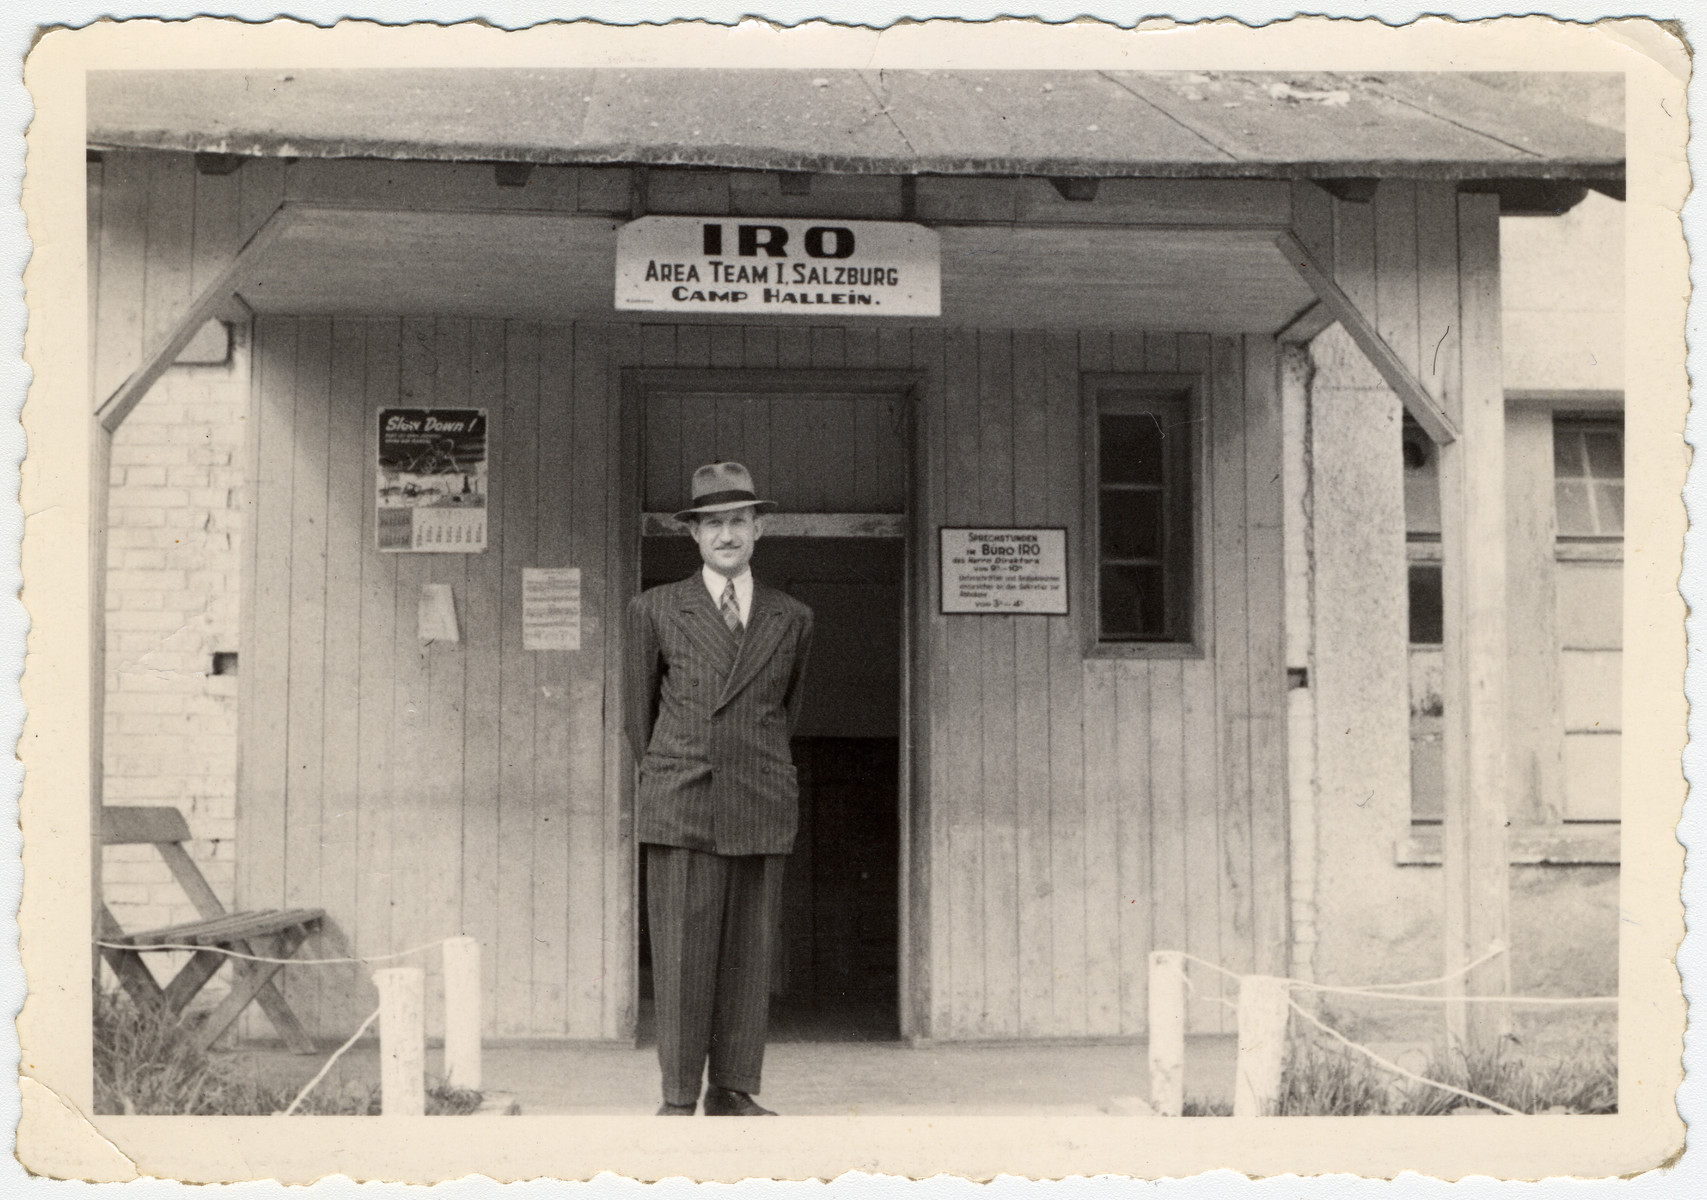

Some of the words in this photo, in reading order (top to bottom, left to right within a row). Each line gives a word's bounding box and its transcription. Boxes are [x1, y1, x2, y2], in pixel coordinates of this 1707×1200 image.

[702, 223, 856, 259] IRO
[644, 259, 700, 283] AREA
[708, 260, 768, 284] TEAM
[792, 263, 898, 287] SALZBURG
[671, 286, 749, 303] CAMP
[385, 415, 421, 432] Slow
[424, 416, 465, 432] Down
[968, 532, 1038, 543] SPRECHSTUNDEN
[1018, 543, 1041, 556] IRO
